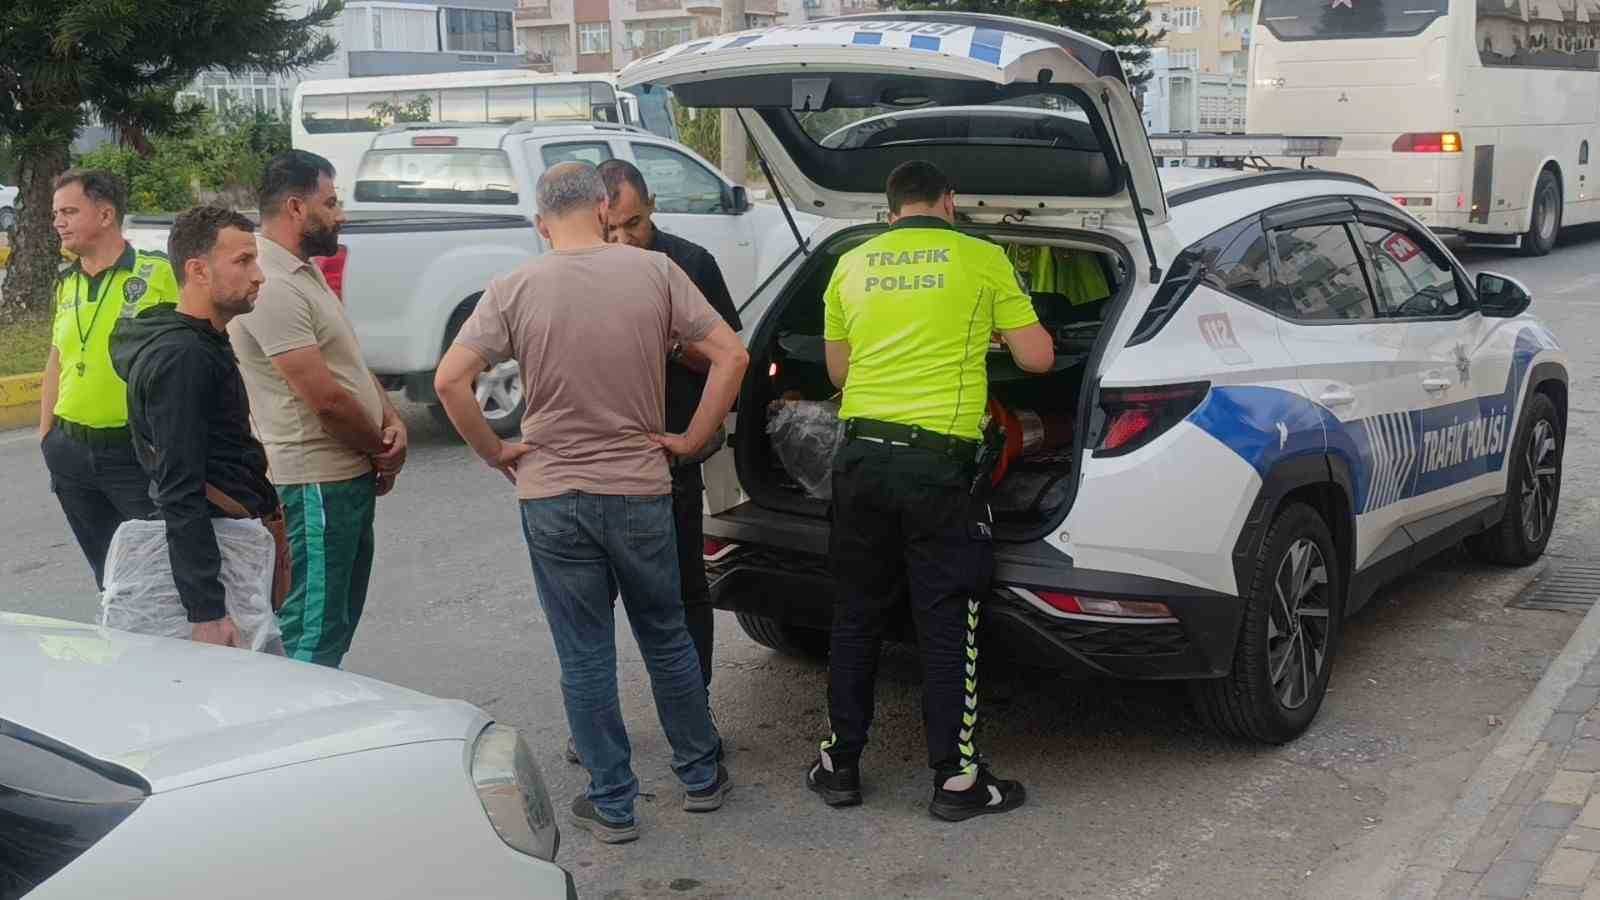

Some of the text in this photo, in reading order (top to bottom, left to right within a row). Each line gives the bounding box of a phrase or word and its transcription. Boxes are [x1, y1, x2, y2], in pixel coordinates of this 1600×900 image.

[1203, 319, 1231, 346] 112
[1421, 405, 1507, 473] TRAFİK POLİSİ
